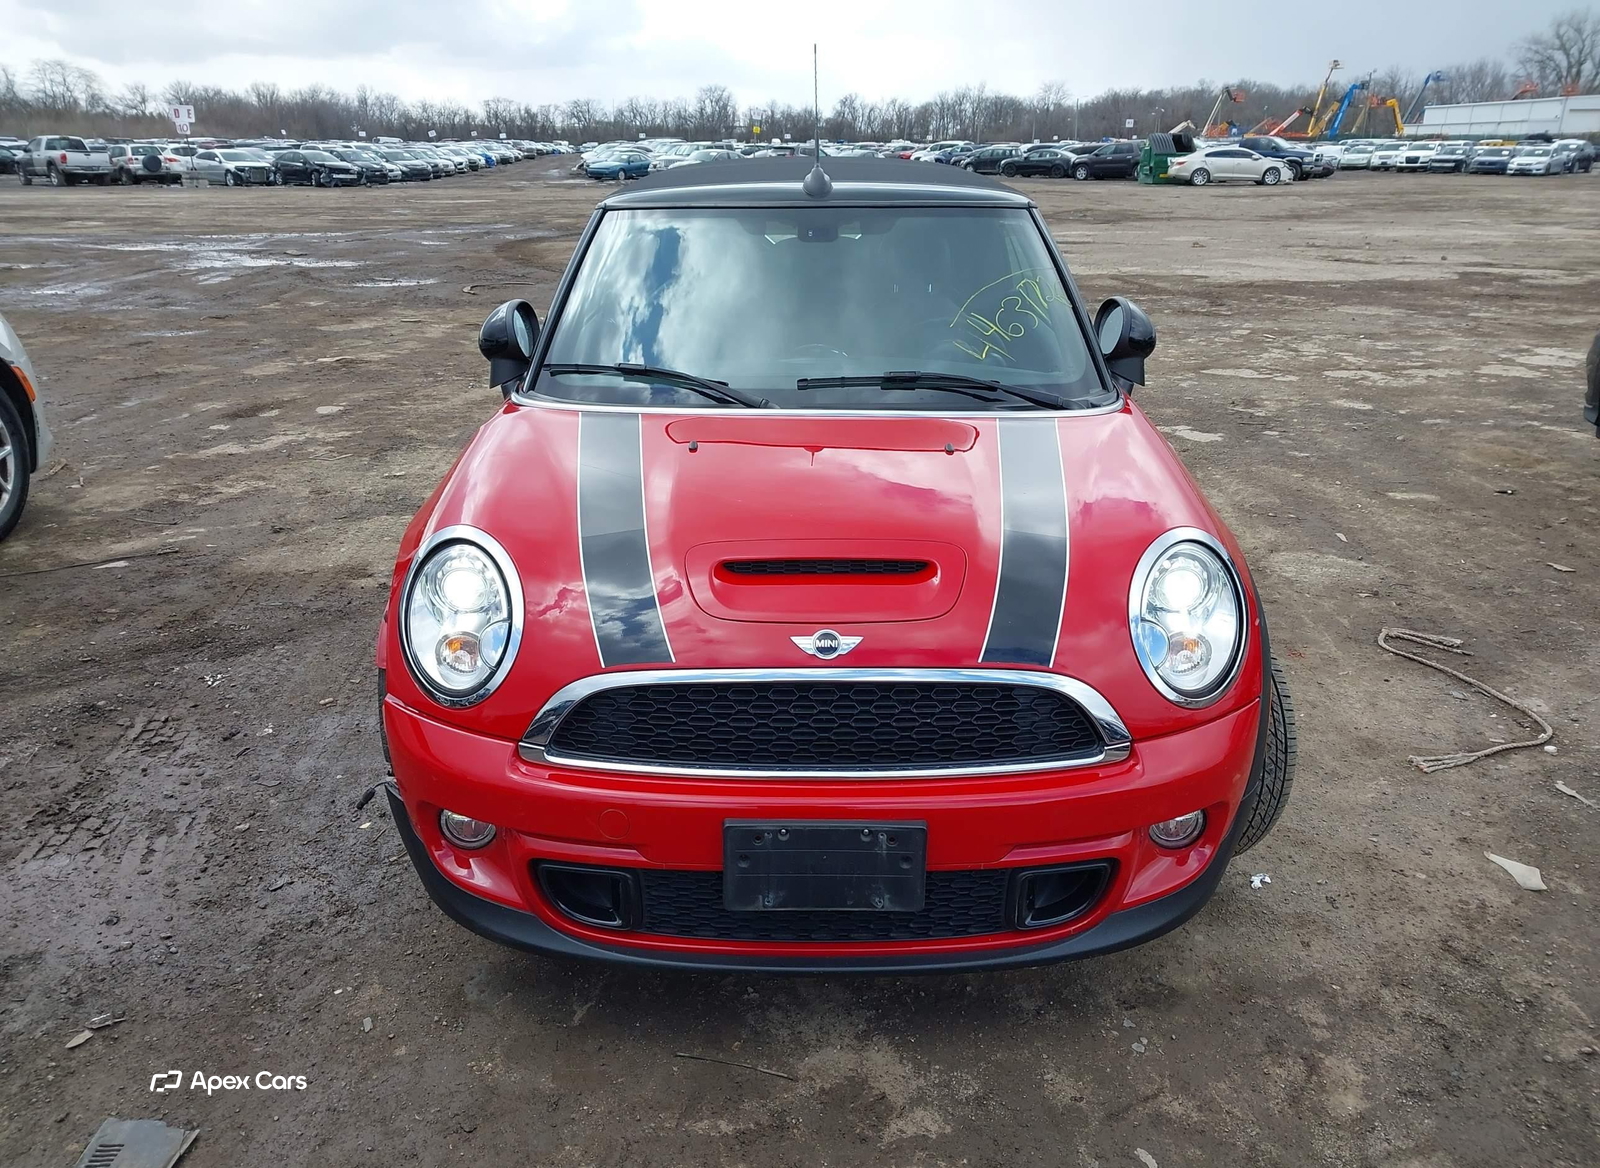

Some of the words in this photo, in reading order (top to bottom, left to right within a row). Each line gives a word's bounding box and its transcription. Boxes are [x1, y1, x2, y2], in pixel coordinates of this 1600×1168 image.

[173, 108, 180, 118] D
[187, 108, 192, 119] E
[178, 123, 188, 132] 10
[815, 639, 838, 648] MINI
